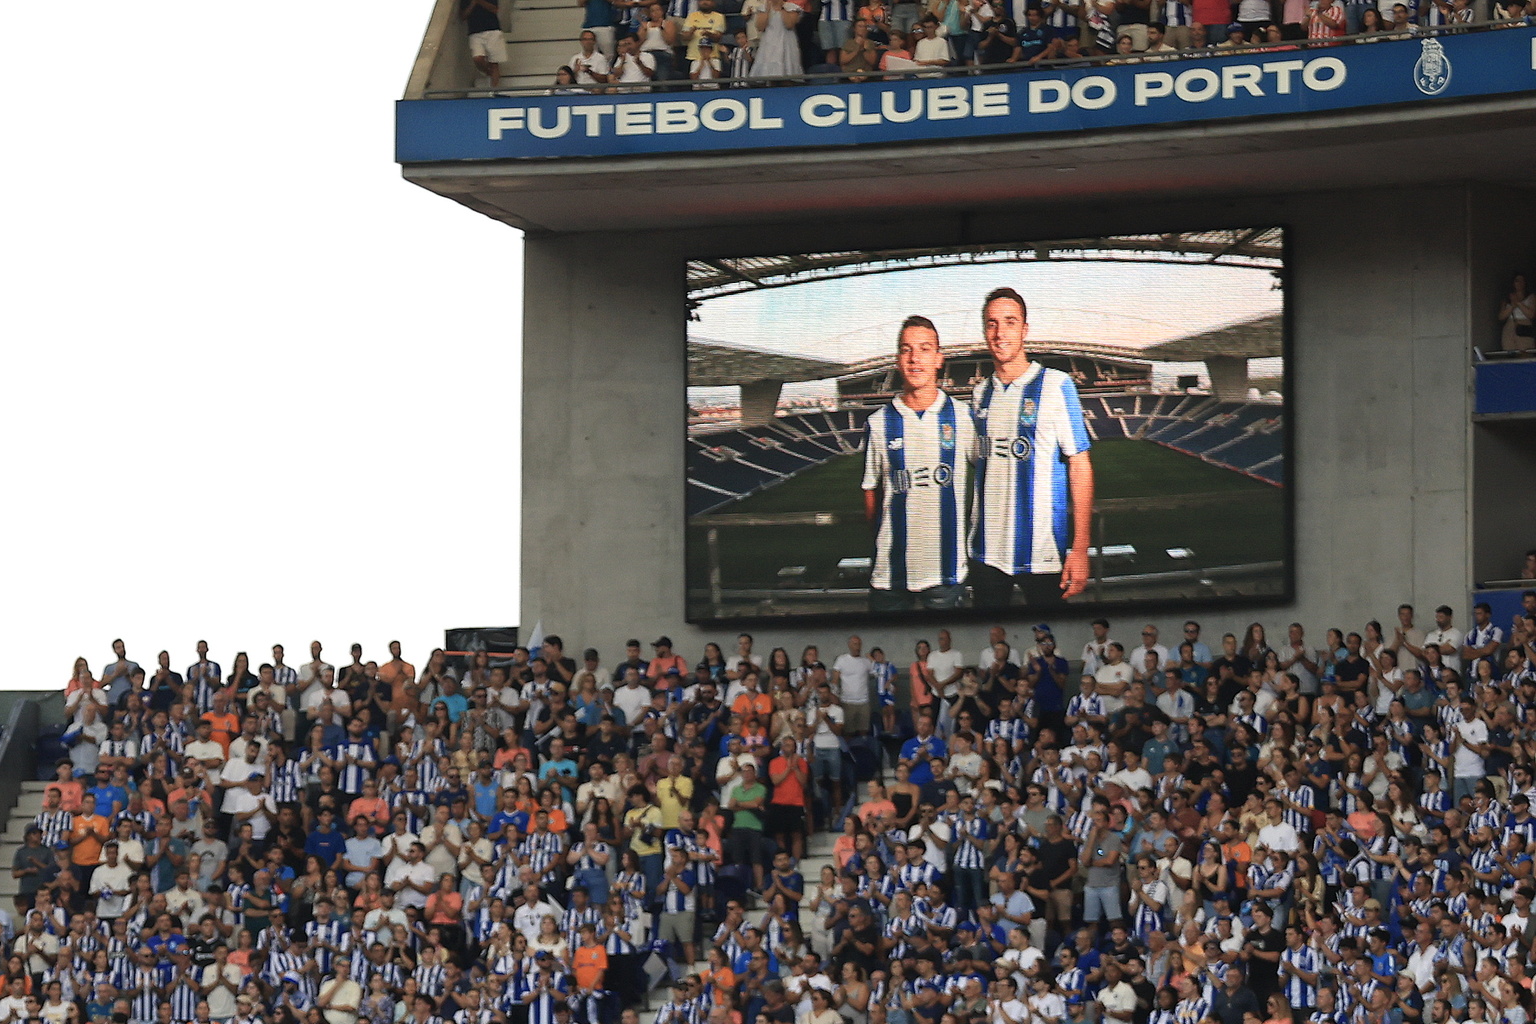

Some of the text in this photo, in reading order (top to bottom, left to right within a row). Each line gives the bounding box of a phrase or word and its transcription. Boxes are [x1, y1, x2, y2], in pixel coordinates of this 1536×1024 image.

[488, 56, 1347, 140] FUTEBOL CLUBE DO PORTO
